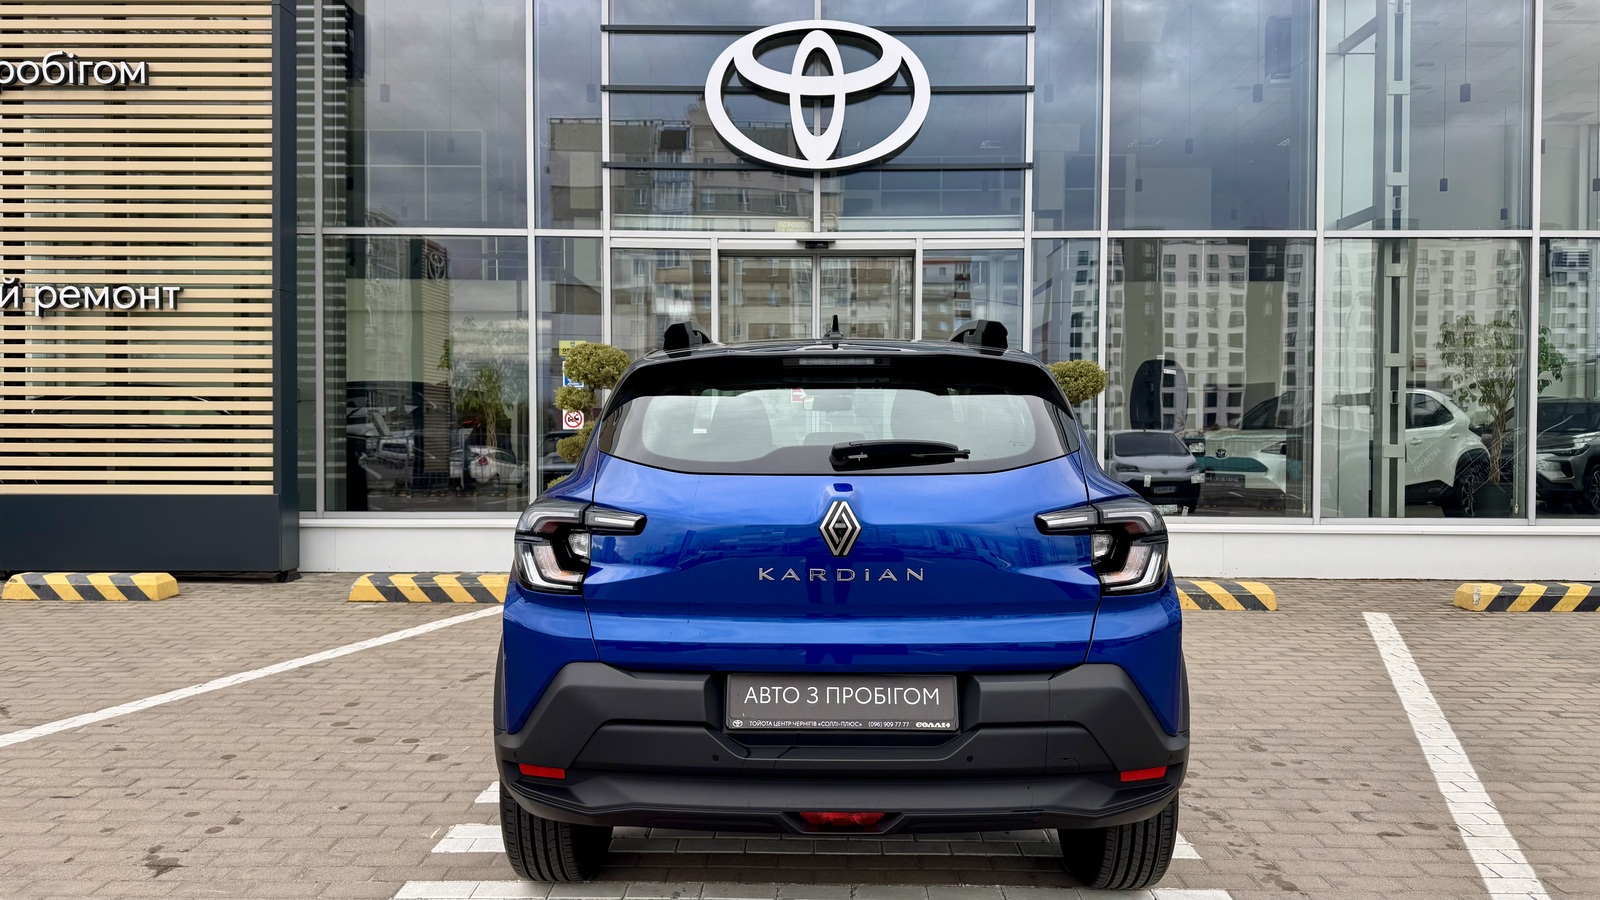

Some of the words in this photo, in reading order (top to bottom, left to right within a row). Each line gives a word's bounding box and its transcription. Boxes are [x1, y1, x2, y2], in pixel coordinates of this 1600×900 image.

[34, 285, 181, 317] ремонт
[758, 568, 924, 582] KARDIAN
[744, 686, 800, 704] АВТО
[806, 686, 819, 704] З
[826, 687, 940, 706] ПРОБІГОМ
